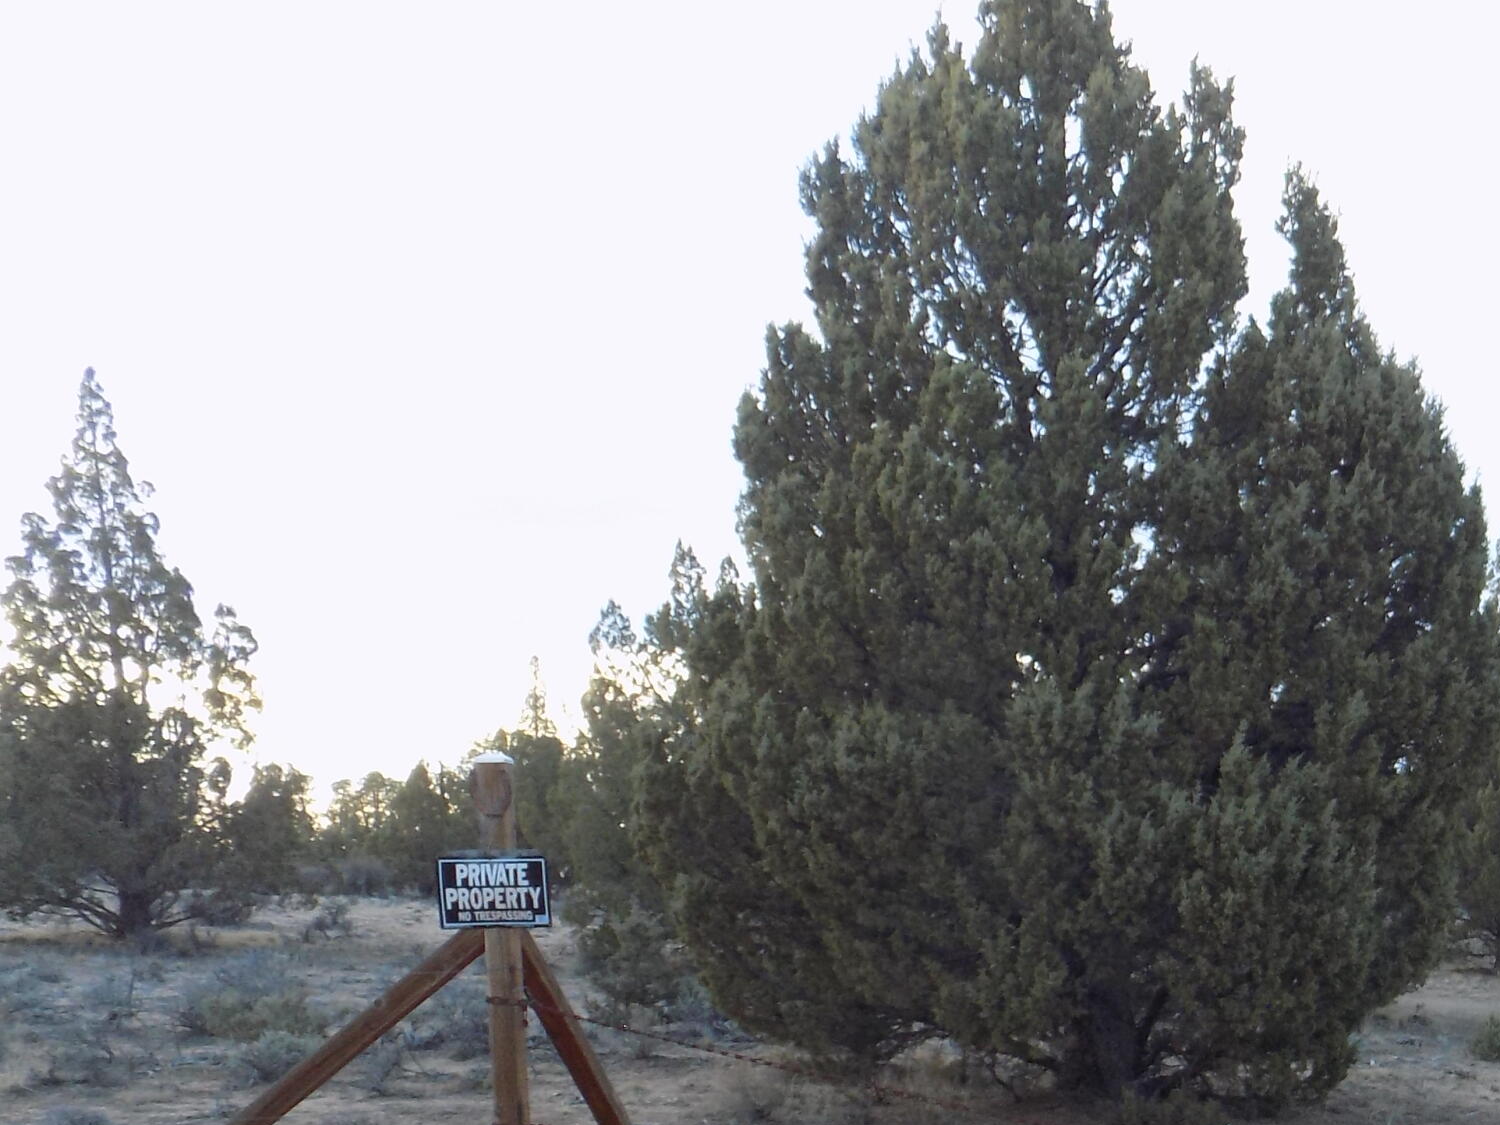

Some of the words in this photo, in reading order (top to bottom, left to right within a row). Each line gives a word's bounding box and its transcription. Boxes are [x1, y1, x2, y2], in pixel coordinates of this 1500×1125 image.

[455, 863, 529, 886] PRIVATE
[445, 887, 541, 910] PROPERTY
[458, 911, 471, 922] NO
[475, 910, 534, 921] TRESPASSING
